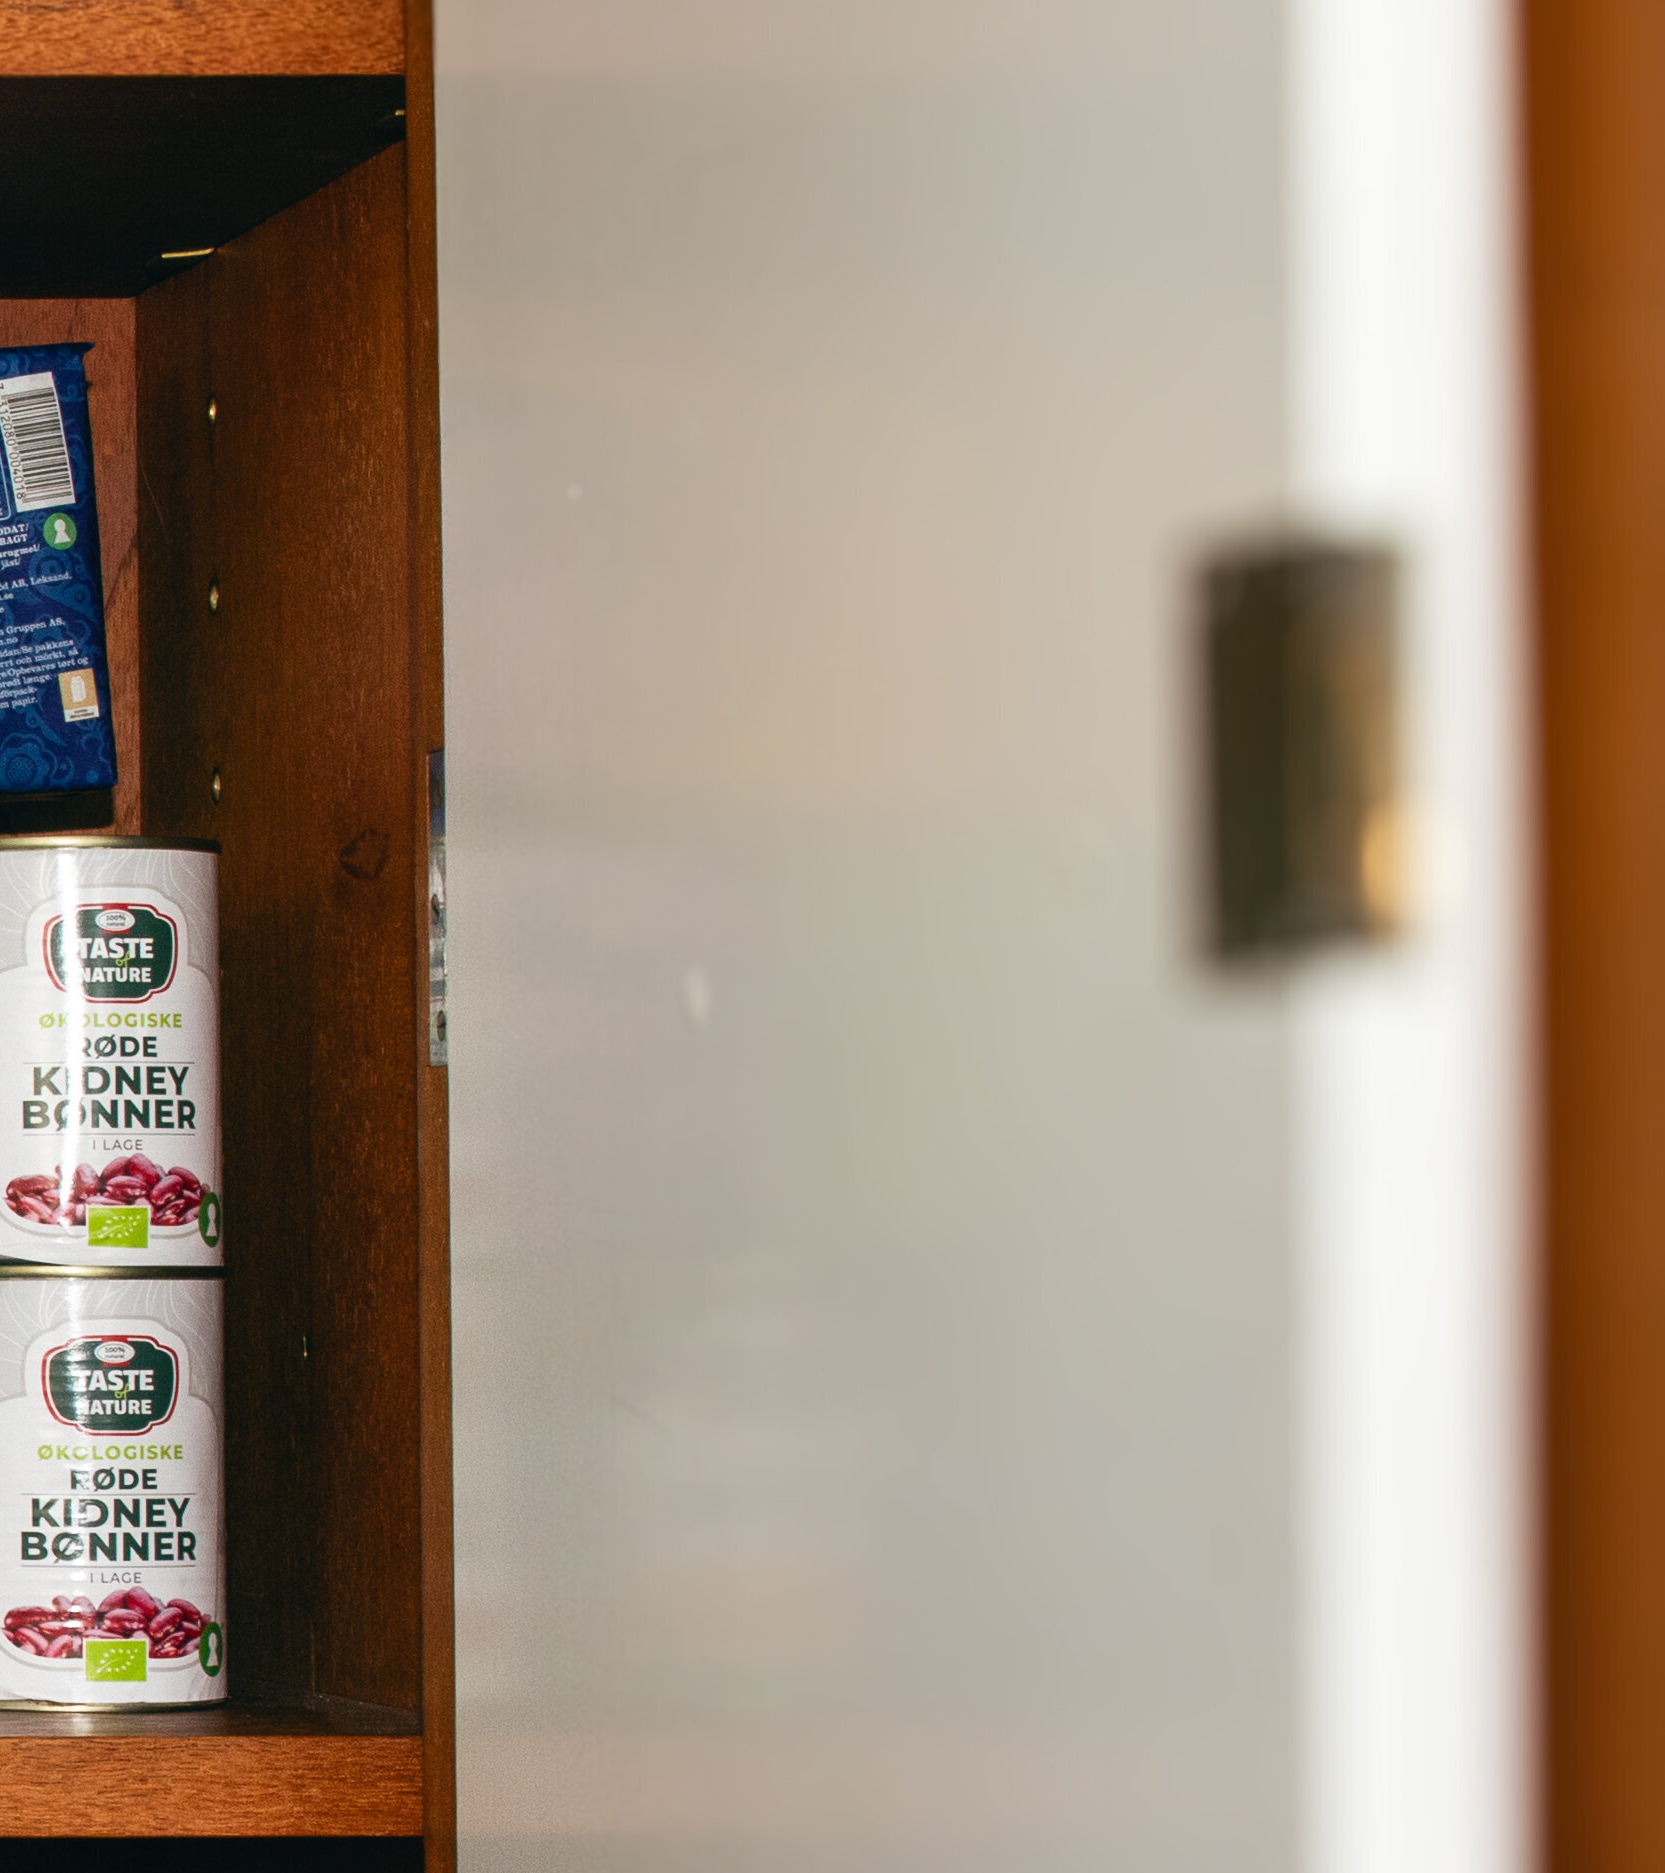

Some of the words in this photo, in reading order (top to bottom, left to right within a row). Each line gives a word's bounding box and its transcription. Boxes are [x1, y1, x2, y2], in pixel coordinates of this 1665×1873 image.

[8, 451, 27, 501] 004018
[5, 619, 48, 639] Gruppen
[76, 937, 154, 959] TASTE
[81, 966, 152, 983] NATURE
[103, 1139, 143, 1150] LAGE
[73, 1370, 154, 1391] TASTE
[37, 1443, 184, 1463] ØKOLOGISKE
[70, 1467, 158, 1492] RØDE
[31, 1498, 190, 1528] KIDNEY
[21, 1530, 197, 1564] BØNNER
[101, 1572, 143, 1584] LAGE
